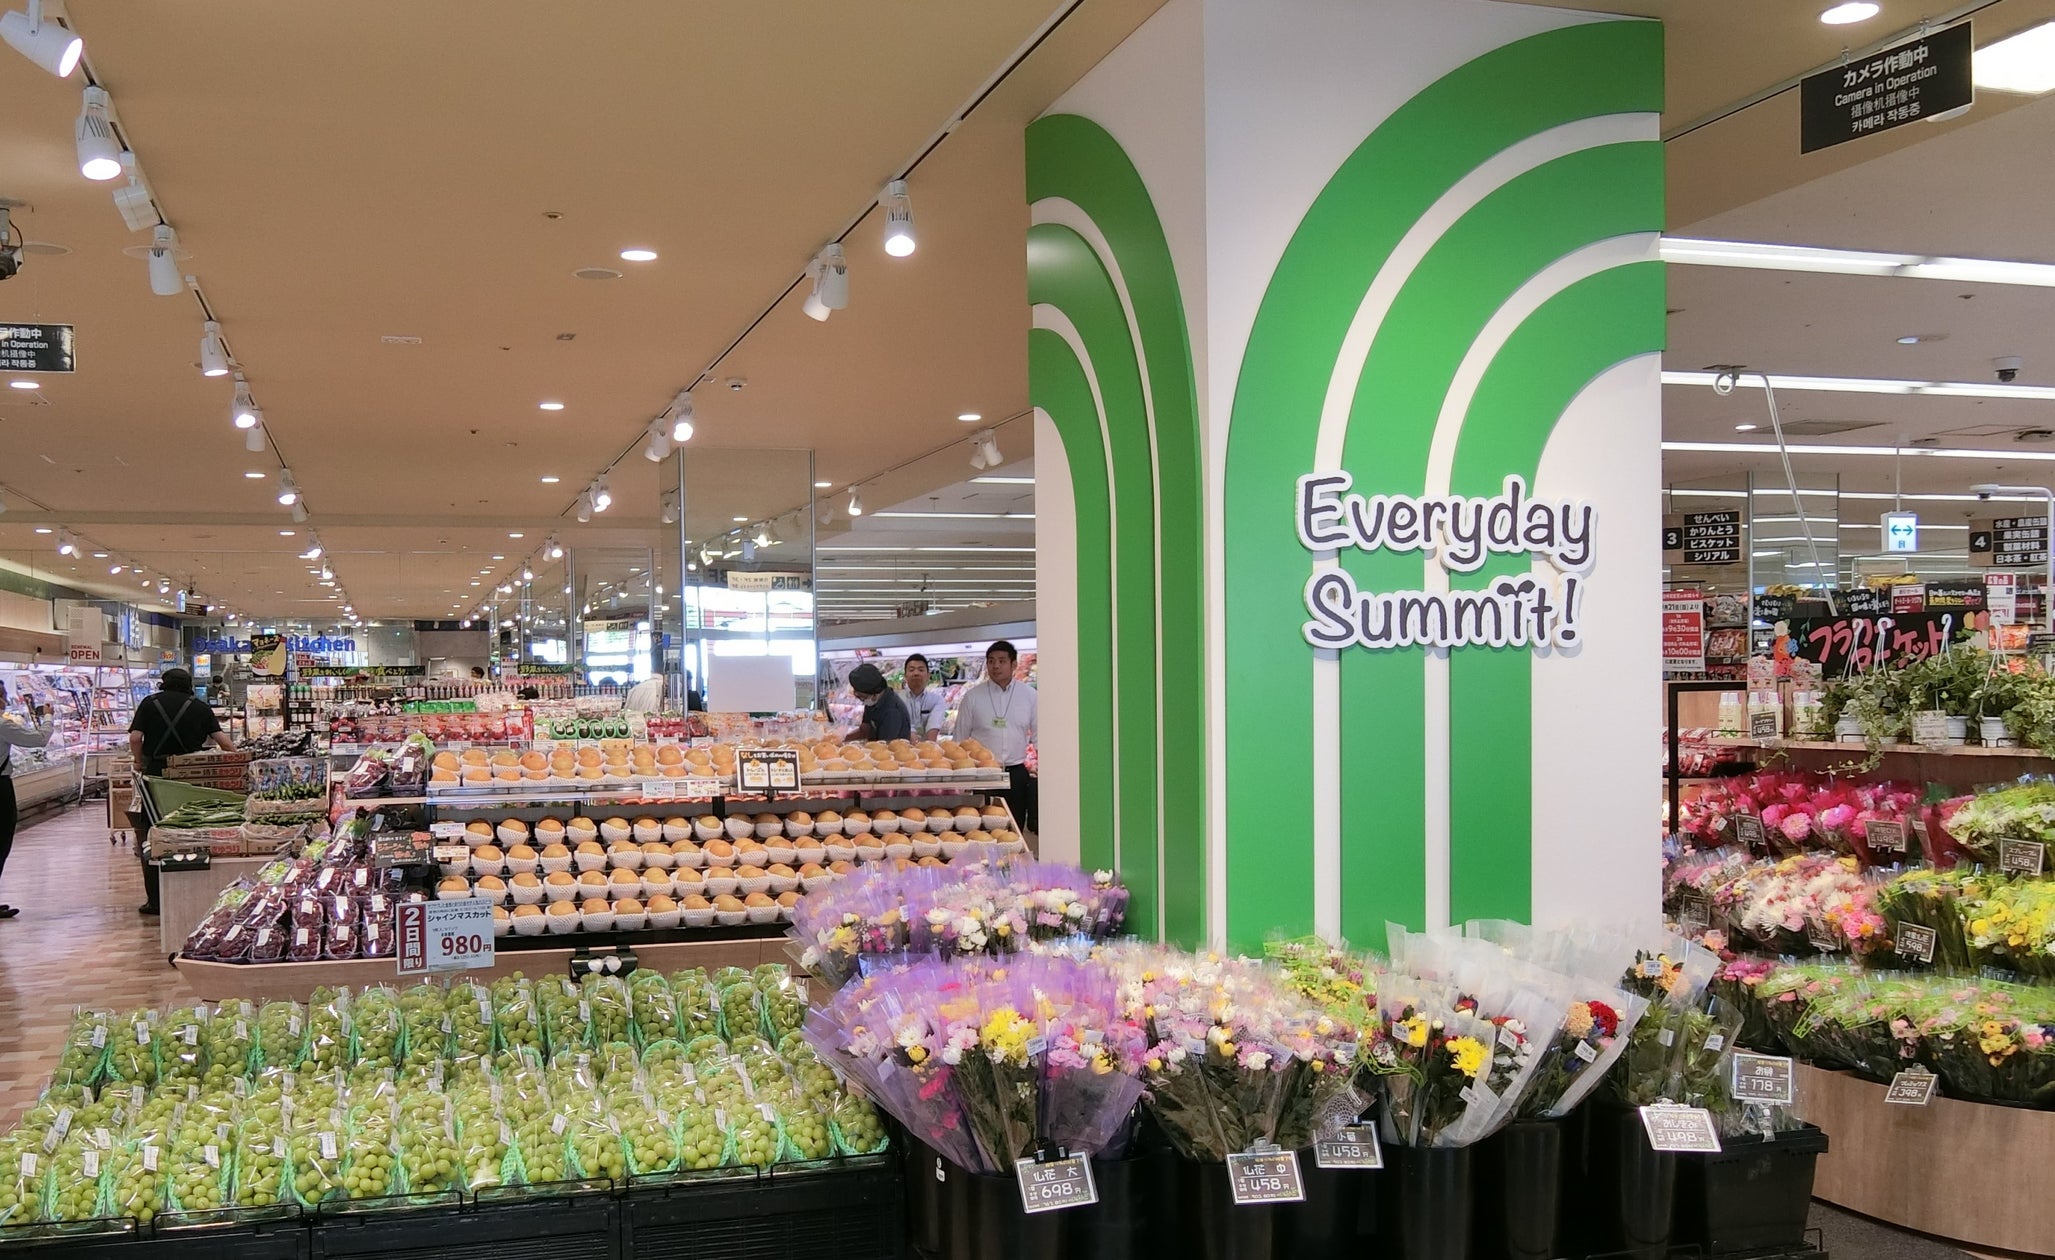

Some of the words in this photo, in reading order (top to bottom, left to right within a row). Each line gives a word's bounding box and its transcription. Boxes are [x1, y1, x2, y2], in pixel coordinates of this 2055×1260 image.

[1843, 45, 1929, 88] カメラ作動中
[1834, 86, 1873, 107] Camera
[1874, 82, 1884, 94] in
[1886, 65, 1938, 90] Operation
[1852, 113, 1885, 132] 카메라
[1887, 101, 1921, 122] 작동중
[10, 341, 49, 349] Operation
[1303, 475, 1592, 566] Everyday
[1693, 514, 1730, 524] せんべい
[1689, 525, 1734, 537] かりんとう
[1666, 532, 1677, 545] 3
[1690, 538, 1734, 548] ビスケット
[1974, 535, 1987, 548] 4
[1694, 551, 1730, 561] シリアル
[1309, 573, 1577, 642] Summit!
[71, 651, 100, 660] OPEN
[427, 910, 492, 923] シャインマスカット
[403, 907, 422, 969] 2日間限り
[1066, 1166, 1078, 1177] 大
[1276, 1163, 1286, 1174] 中
